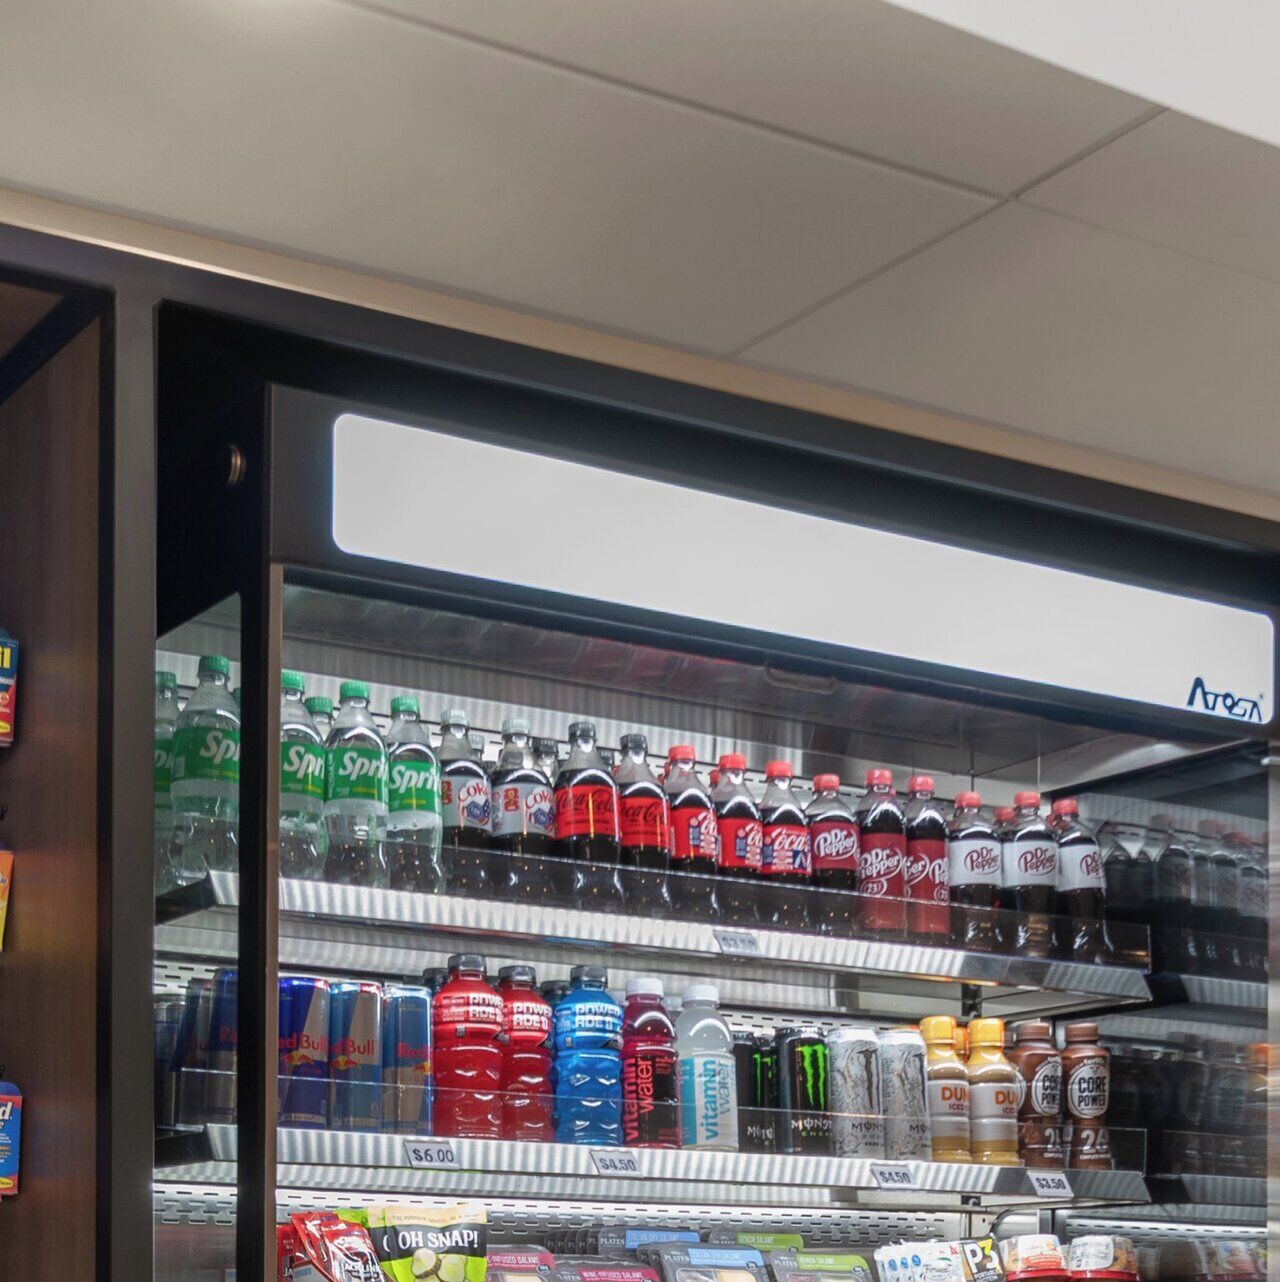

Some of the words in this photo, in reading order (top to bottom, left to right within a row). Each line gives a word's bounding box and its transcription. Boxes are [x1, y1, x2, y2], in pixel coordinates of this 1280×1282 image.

[830, 828, 847, 844] Dr
[816, 831, 858, 858] Pepper
[874, 848, 891, 865] Dr
[980, 847, 994, 859] Dr
[1033, 847, 1048, 860] Dr
[859, 854, 903, 881] Pepper
[968, 850, 1000, 873] Pepper
[1020, 851, 1056, 873] Pepper
[574, 1002, 622, 1017] POWER
[574, 1015, 607, 1030] ADE
[299, 1033, 328, 1051] Bull
[347, 1039, 375, 1056] Bull
[1077, 1076, 1107, 1094] CORE
[622, 1057, 639, 1142] vitamin
[637, 1057, 655, 1116] water
[698, 1058, 718, 1141] vitamin
[1077, 1093, 1107, 1108] POWER
[412, 1148, 455, 1164] $6.00
[599, 1158, 637, 1173] $4.50
[879, 1171, 912, 1185] $4.50
[1035, 1176, 1067, 1191] $3.50
[398, 1231, 424, 1249] OH
[427, 1229, 479, 1249] SNAP!
[600, 1236, 625, 1246] PLATES
[664, 1253, 690, 1263] PLATES
[964, 1238, 1001, 1274] P3
[581, 1270, 621, 1280] WINE-INFUSED
